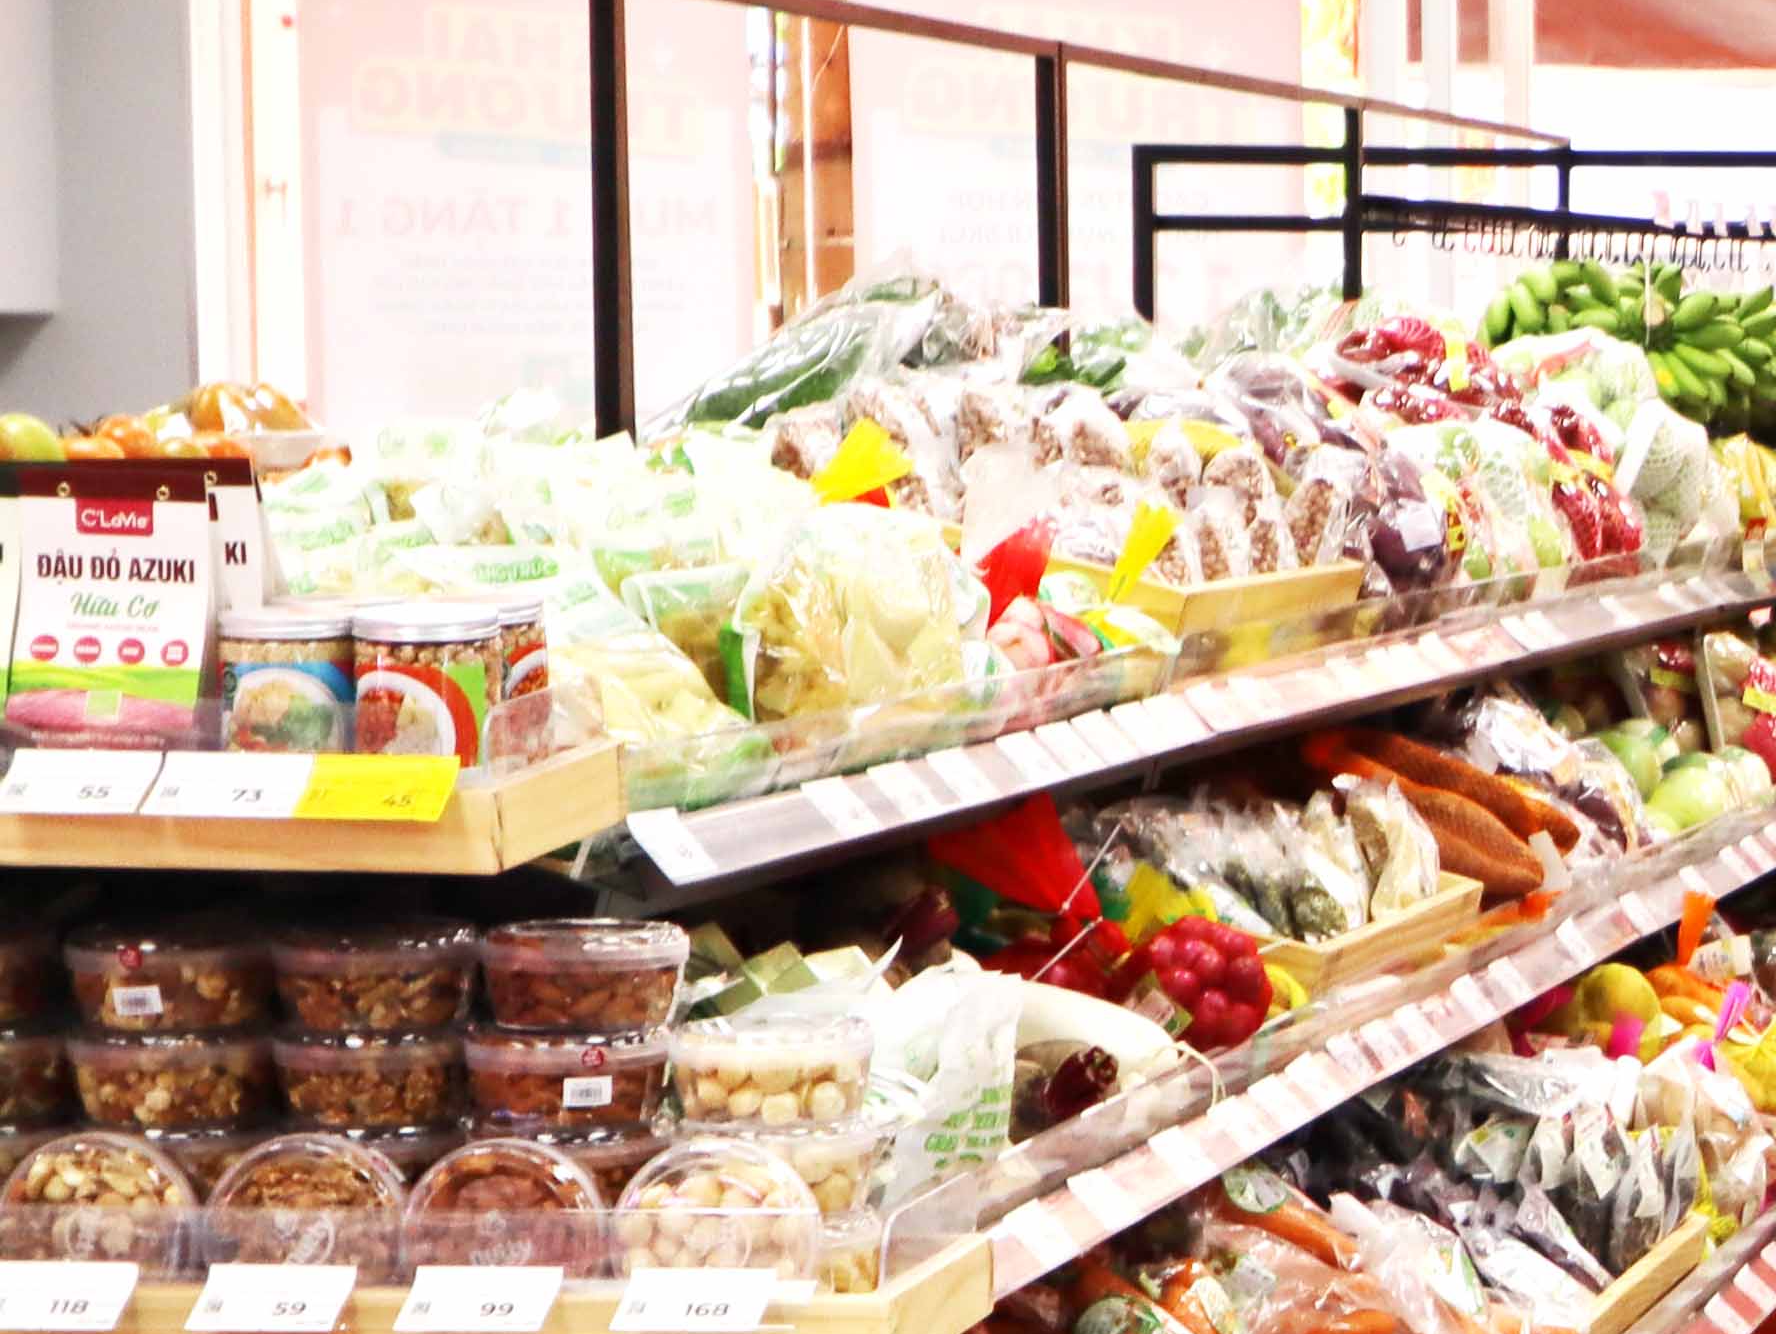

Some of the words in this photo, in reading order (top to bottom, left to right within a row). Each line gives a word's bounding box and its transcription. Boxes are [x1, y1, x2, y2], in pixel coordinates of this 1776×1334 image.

[37, 551, 84, 586] ĐẬU
[91, 548, 119, 581] ĐỎ
[128, 558, 195, 583] AZUKI
[76, 784, 112, 800] 55
[47, 1299, 89, 1318] 118
[272, 1299, 308, 1318] 59
[480, 1300, 516, 1319] 99
[683, 1299, 730, 1319] 168
